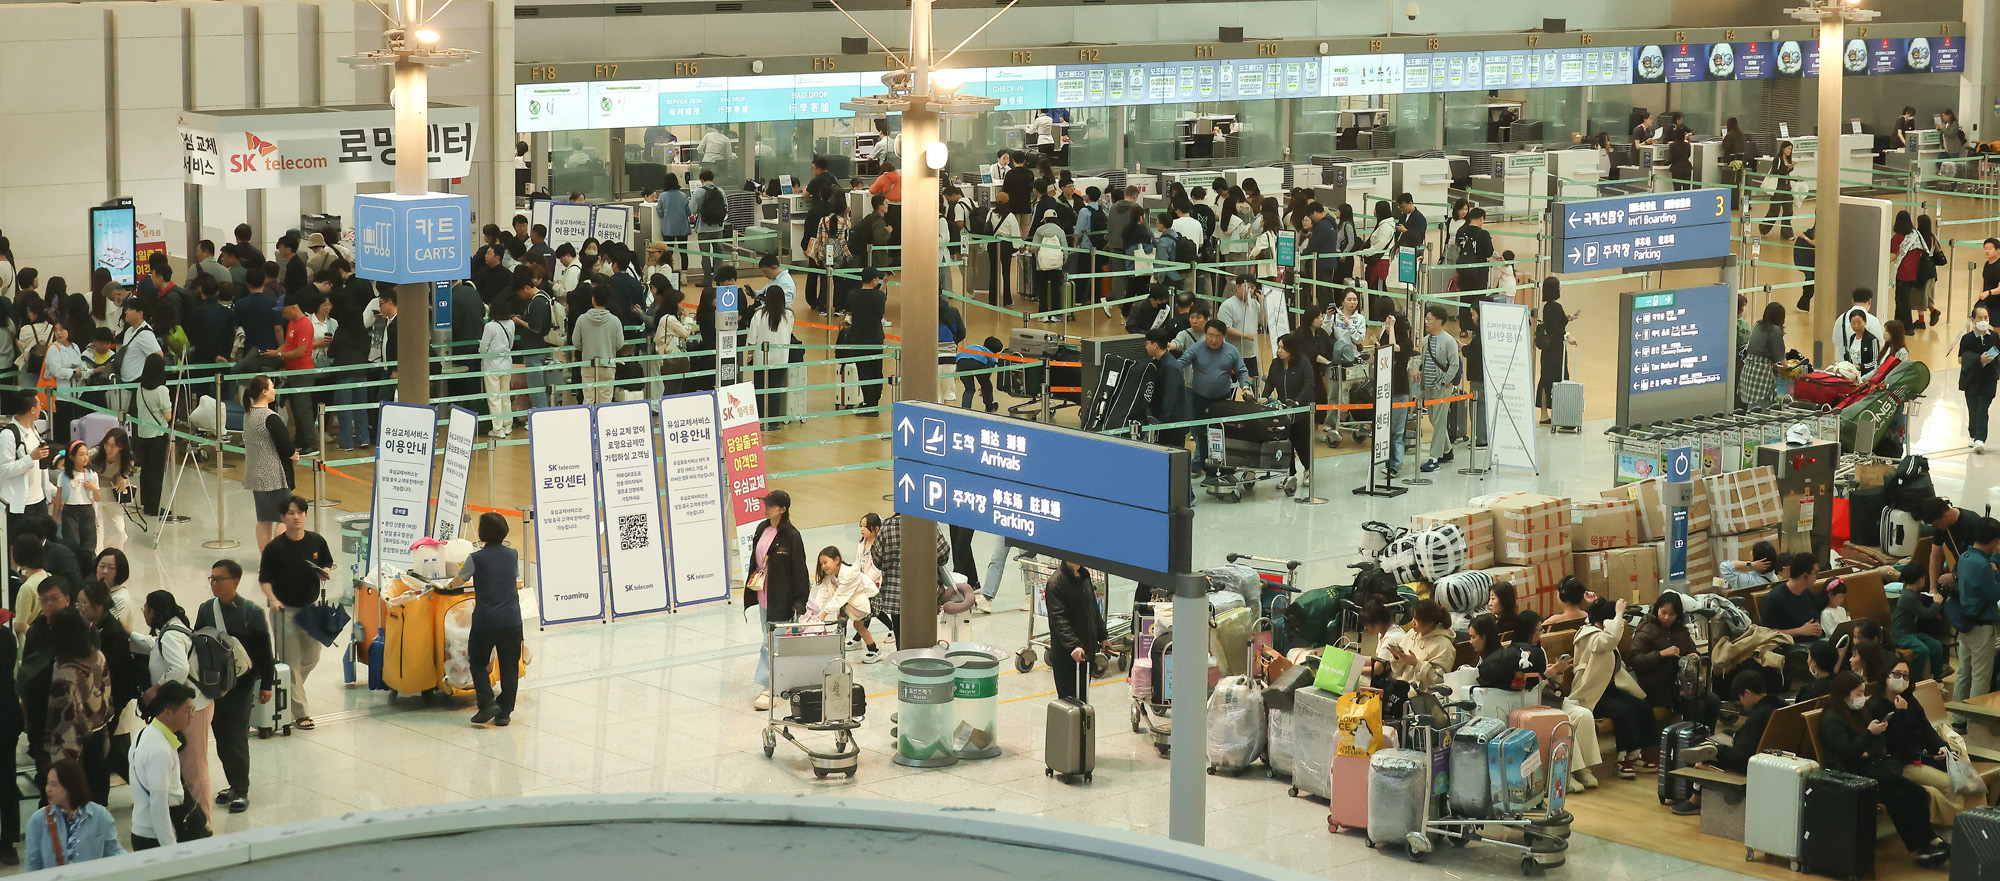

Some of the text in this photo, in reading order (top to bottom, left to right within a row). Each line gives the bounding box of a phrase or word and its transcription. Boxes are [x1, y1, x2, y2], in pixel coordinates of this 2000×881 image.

[1676, 32, 1686, 41] F5
[1726, 30, 1735, 40] F4
[1860, 27, 1868, 36] F2
[1941, 25, 1950, 35] F1
[1370, 40, 1382, 51] F9
[1428, 39, 1438, 50] F8
[1528, 35, 1539, 46] F7
[1581, 34, 1592, 45] F6
[1080, 50, 1099, 61] F12
[1196, 46, 1214, 57] F11
[1259, 44, 1277, 55] F10
[814, 57, 835, 70] F15
[1012, 51, 1032, 63] F13
[532, 66, 556, 80] F18
[595, 65, 618, 78] F17
[675, 62, 698, 75] F16
[992, 85, 1024, 93] CHECK-IN
[196, 136, 218, 155] 교체
[230, 154, 328, 173] SK telecom
[1715, 195, 1724, 217] 3
[1584, 209, 1625, 226] 국제선탑승
[1644, 213, 1676, 225] Boarding
[416, 218, 455, 243] 카트
[555, 227, 585, 236] 이용안내
[598, 230, 621, 240] 이용안내
[415, 246, 456, 261] CARTS
[1603, 243, 1631, 259] 주차장
[1634, 249, 1661, 261] Parking
[1380, 356, 1389, 371] SK
[1660, 361, 1679, 369] Refund
[1377, 382, 1390, 399] 로밍
[723, 406, 734, 421] SK
[737, 404, 754, 417] 텔레콤
[667, 417, 710, 428] 유심교체서비스
[1376, 412, 1389, 430] 센터
[385, 427, 429, 439] 유심교체서비스
[606, 425, 645, 437] 유심 교체 없이
[670, 428, 710, 444] 이용안내
[386, 440, 427, 455] 이용안내
[608, 438, 645, 449] 로밍요금제만
[726, 432, 760, 453] 당일출국
[952, 432, 975, 454] 도착
[1375, 440, 1389, 458] 입구
[605, 450, 650, 462] 가입하실 고객님
[734, 453, 758, 472] 여객만
[980, 450, 1021, 472] Arrivals
[543, 474, 586, 489] 로밍센터
[733, 474, 766, 497] 유심교체
[743, 498, 761, 513] 가능
[953, 488, 987, 514] 주차장
[993, 488, 1061, 518] 停车场 駐車場
[993, 509, 1035, 537] Parking
[561, 592, 588, 601] roaming
